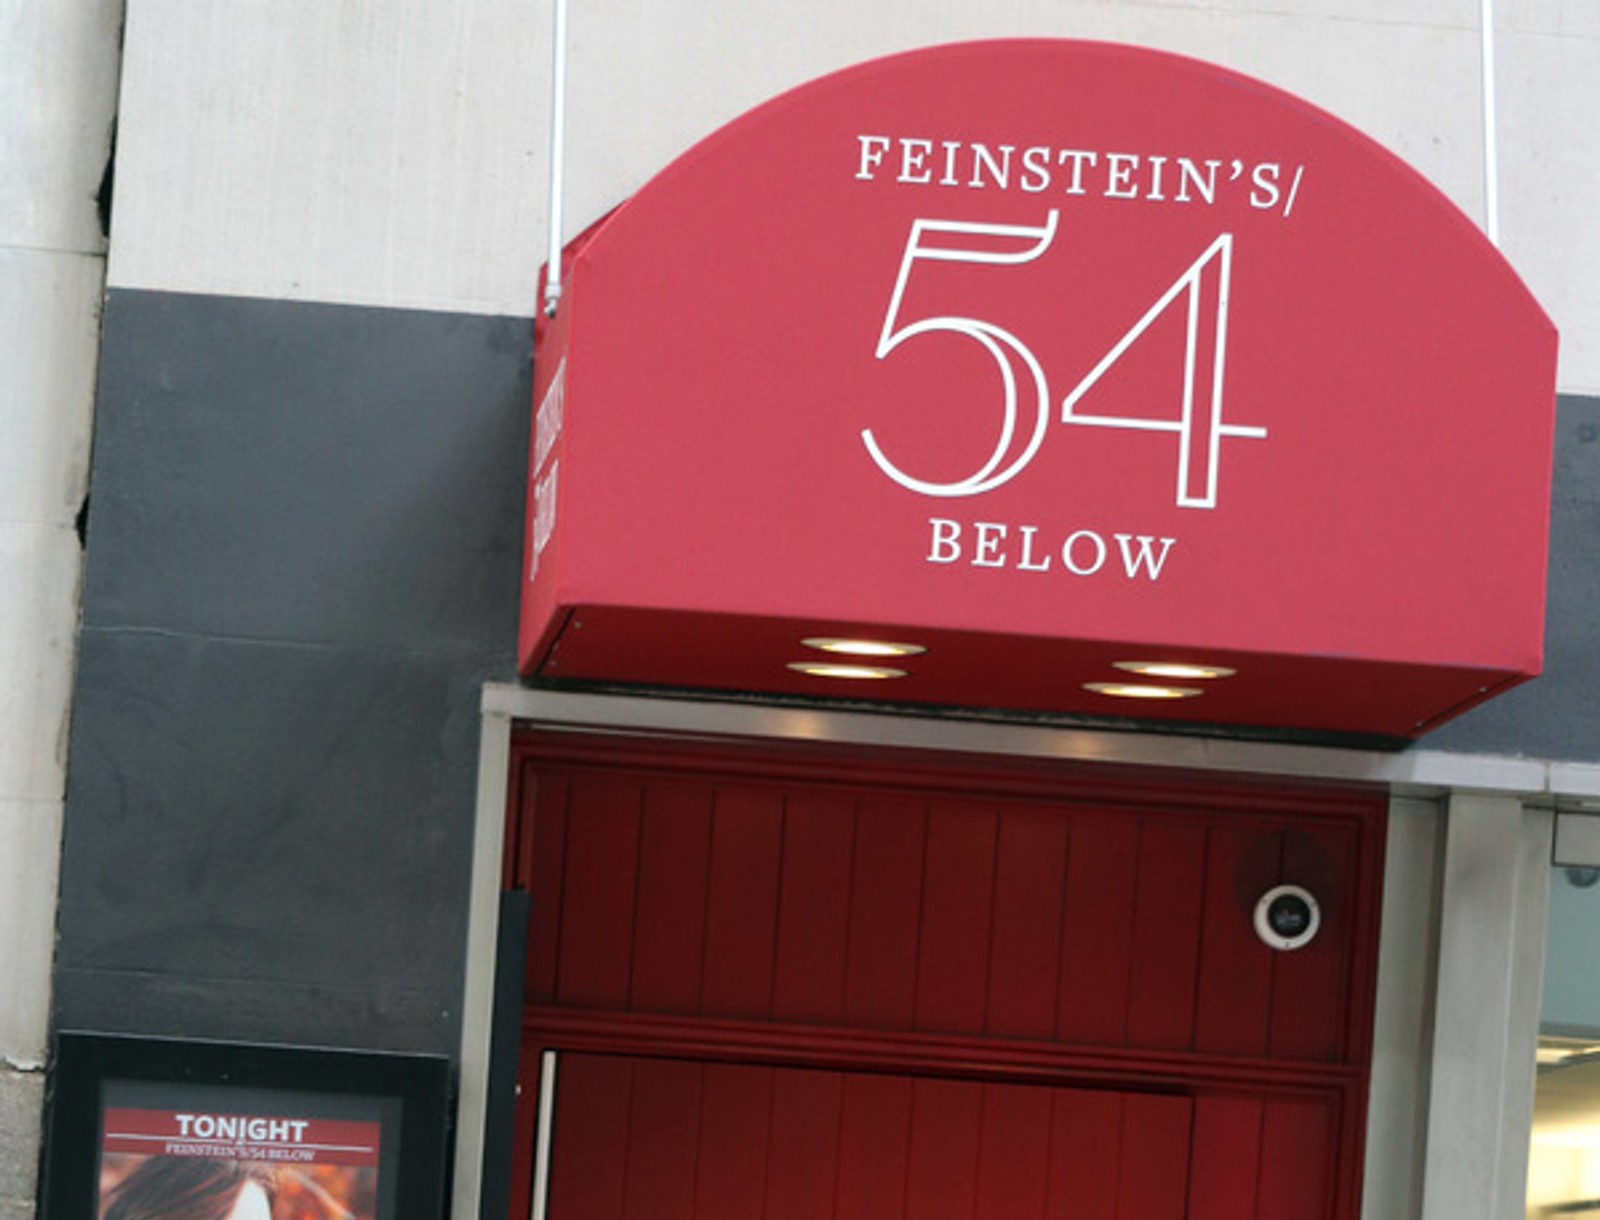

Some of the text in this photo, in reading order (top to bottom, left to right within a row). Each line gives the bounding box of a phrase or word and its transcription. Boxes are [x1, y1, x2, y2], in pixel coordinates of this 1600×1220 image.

[861, 208, 1268, 509] 54
[926, 517, 1176, 581] BELOW
[175, 1114, 309, 1143] TONIGHT
[269, 1149, 316, 1161] BELOW
